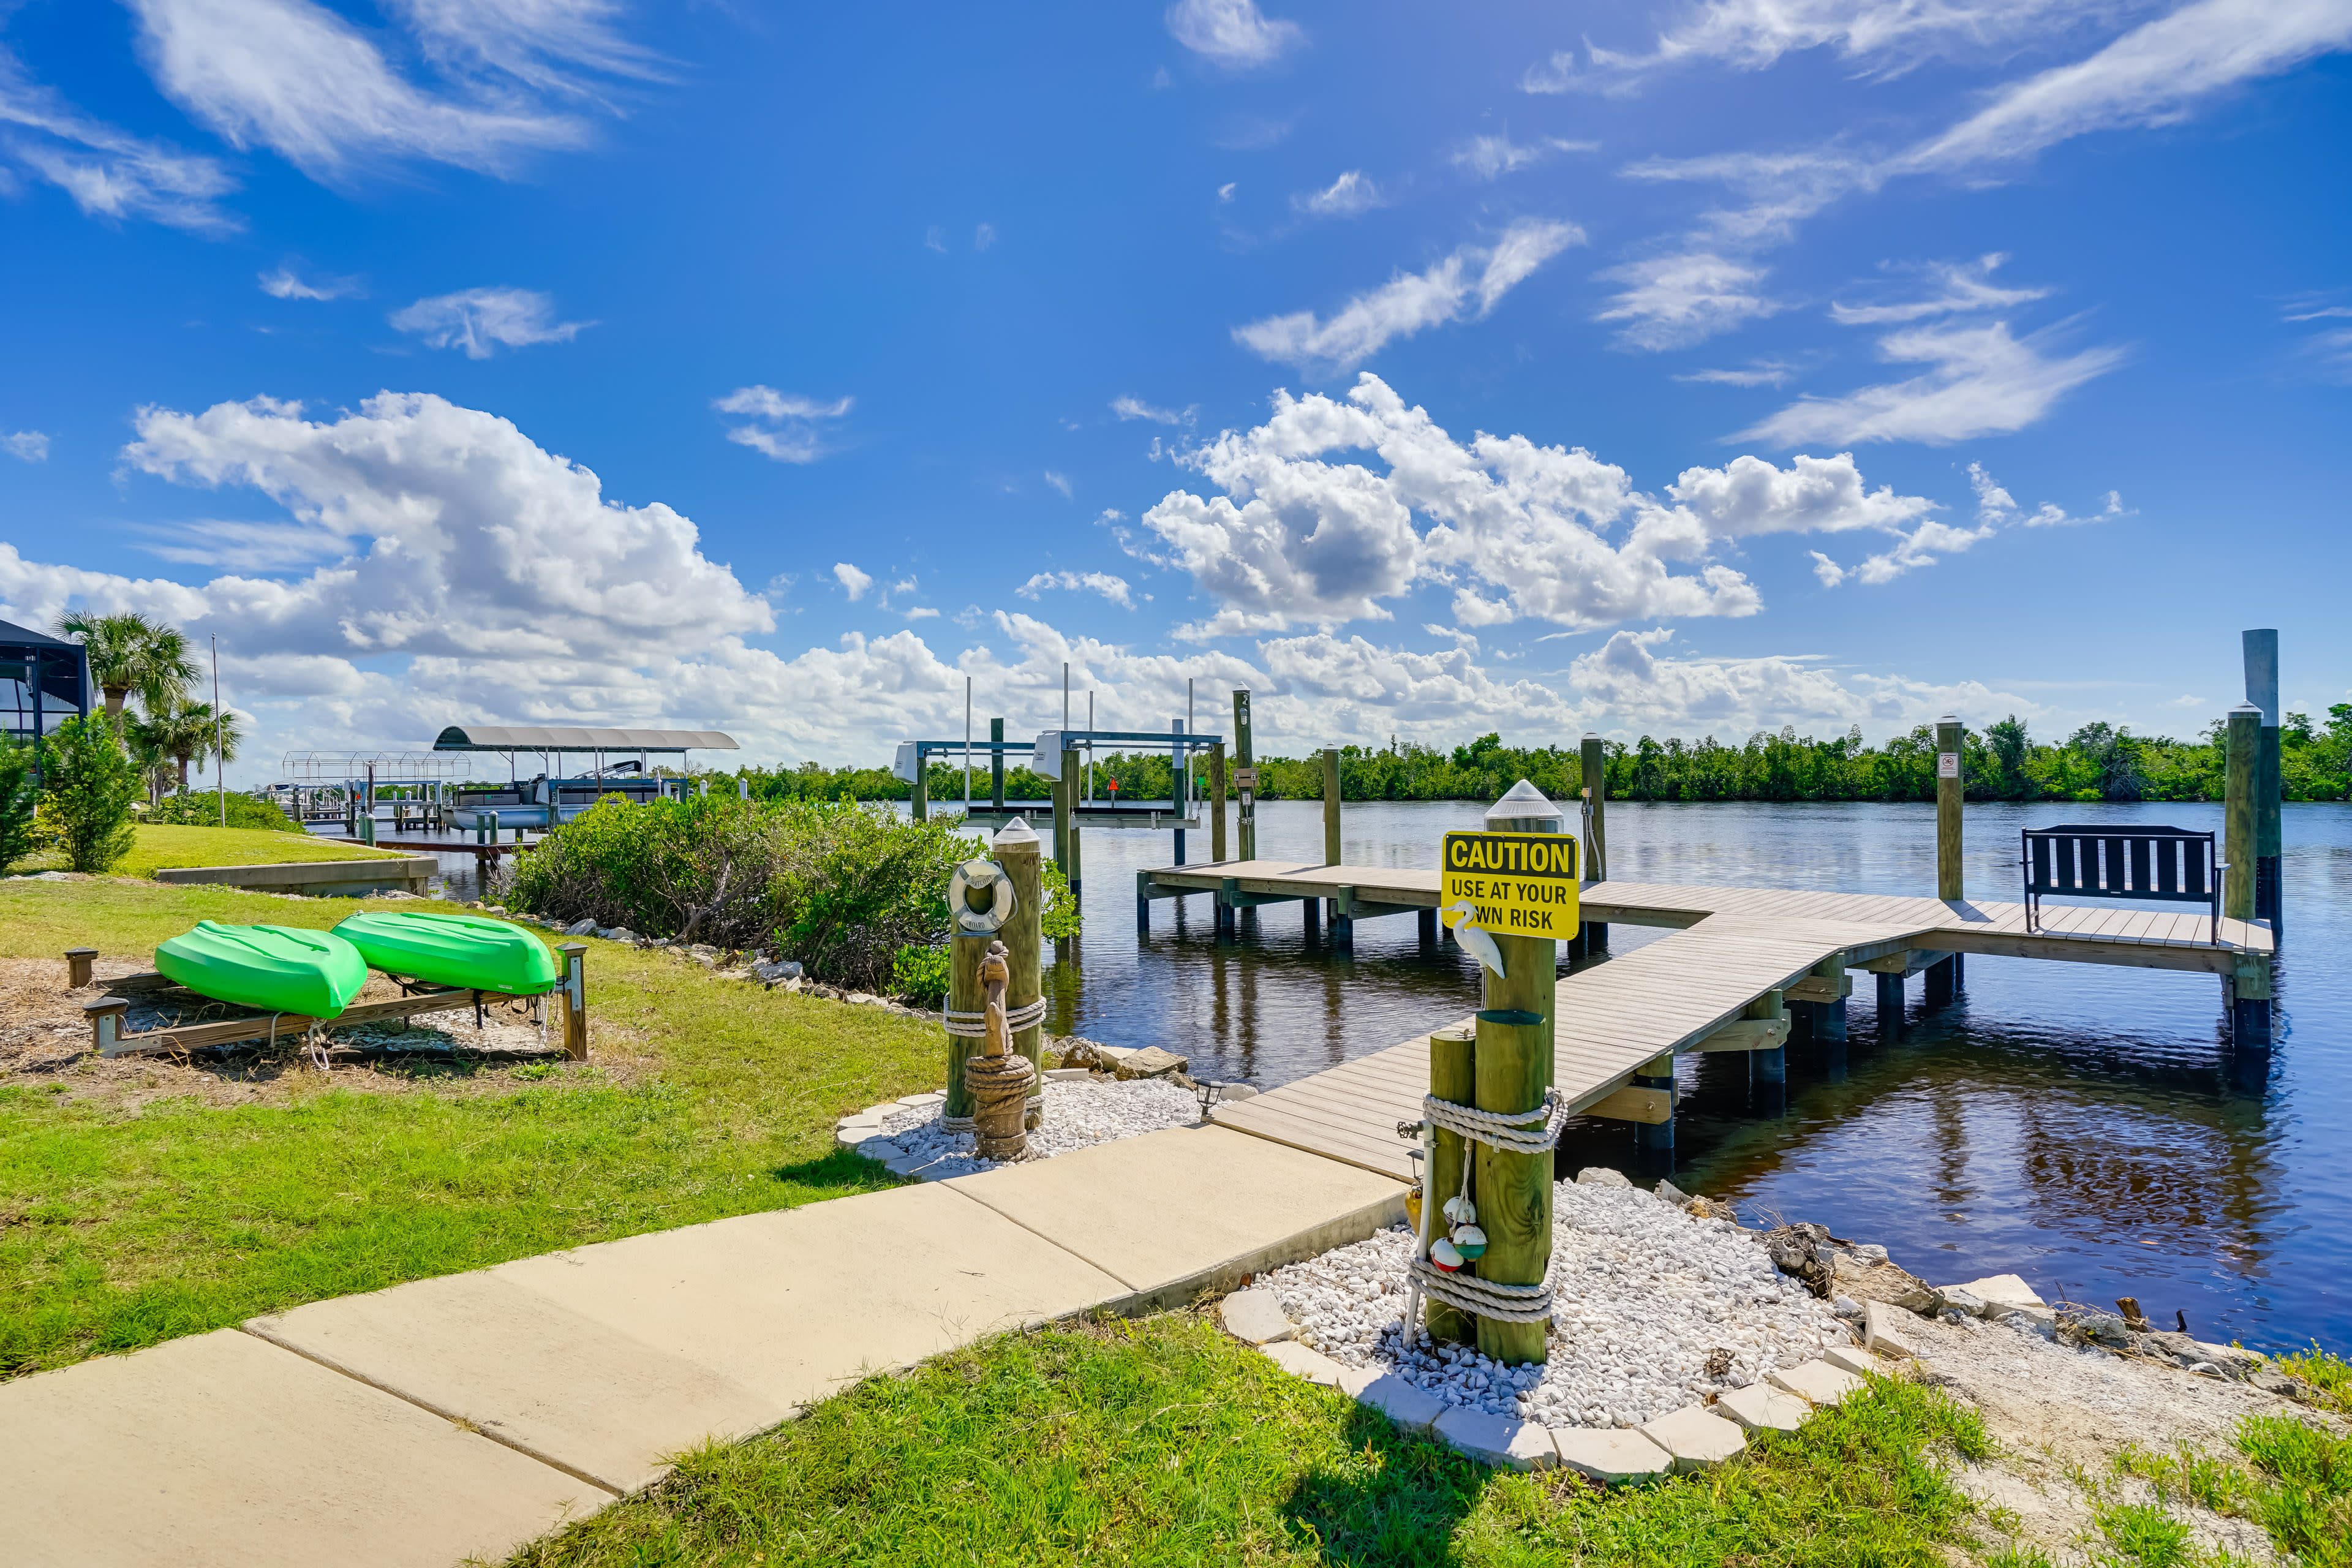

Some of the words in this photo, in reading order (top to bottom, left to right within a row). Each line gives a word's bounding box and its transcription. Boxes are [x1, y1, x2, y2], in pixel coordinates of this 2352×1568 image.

[1450, 840, 1570, 873] CAUTION
[1452, 879, 1485, 898] USE
[1490, 881, 1511, 900] AT
[1516, 883, 1567, 905] YOUR
[1463, 905, 1502, 925] WN
[1510, 908, 1553, 930] RISK
